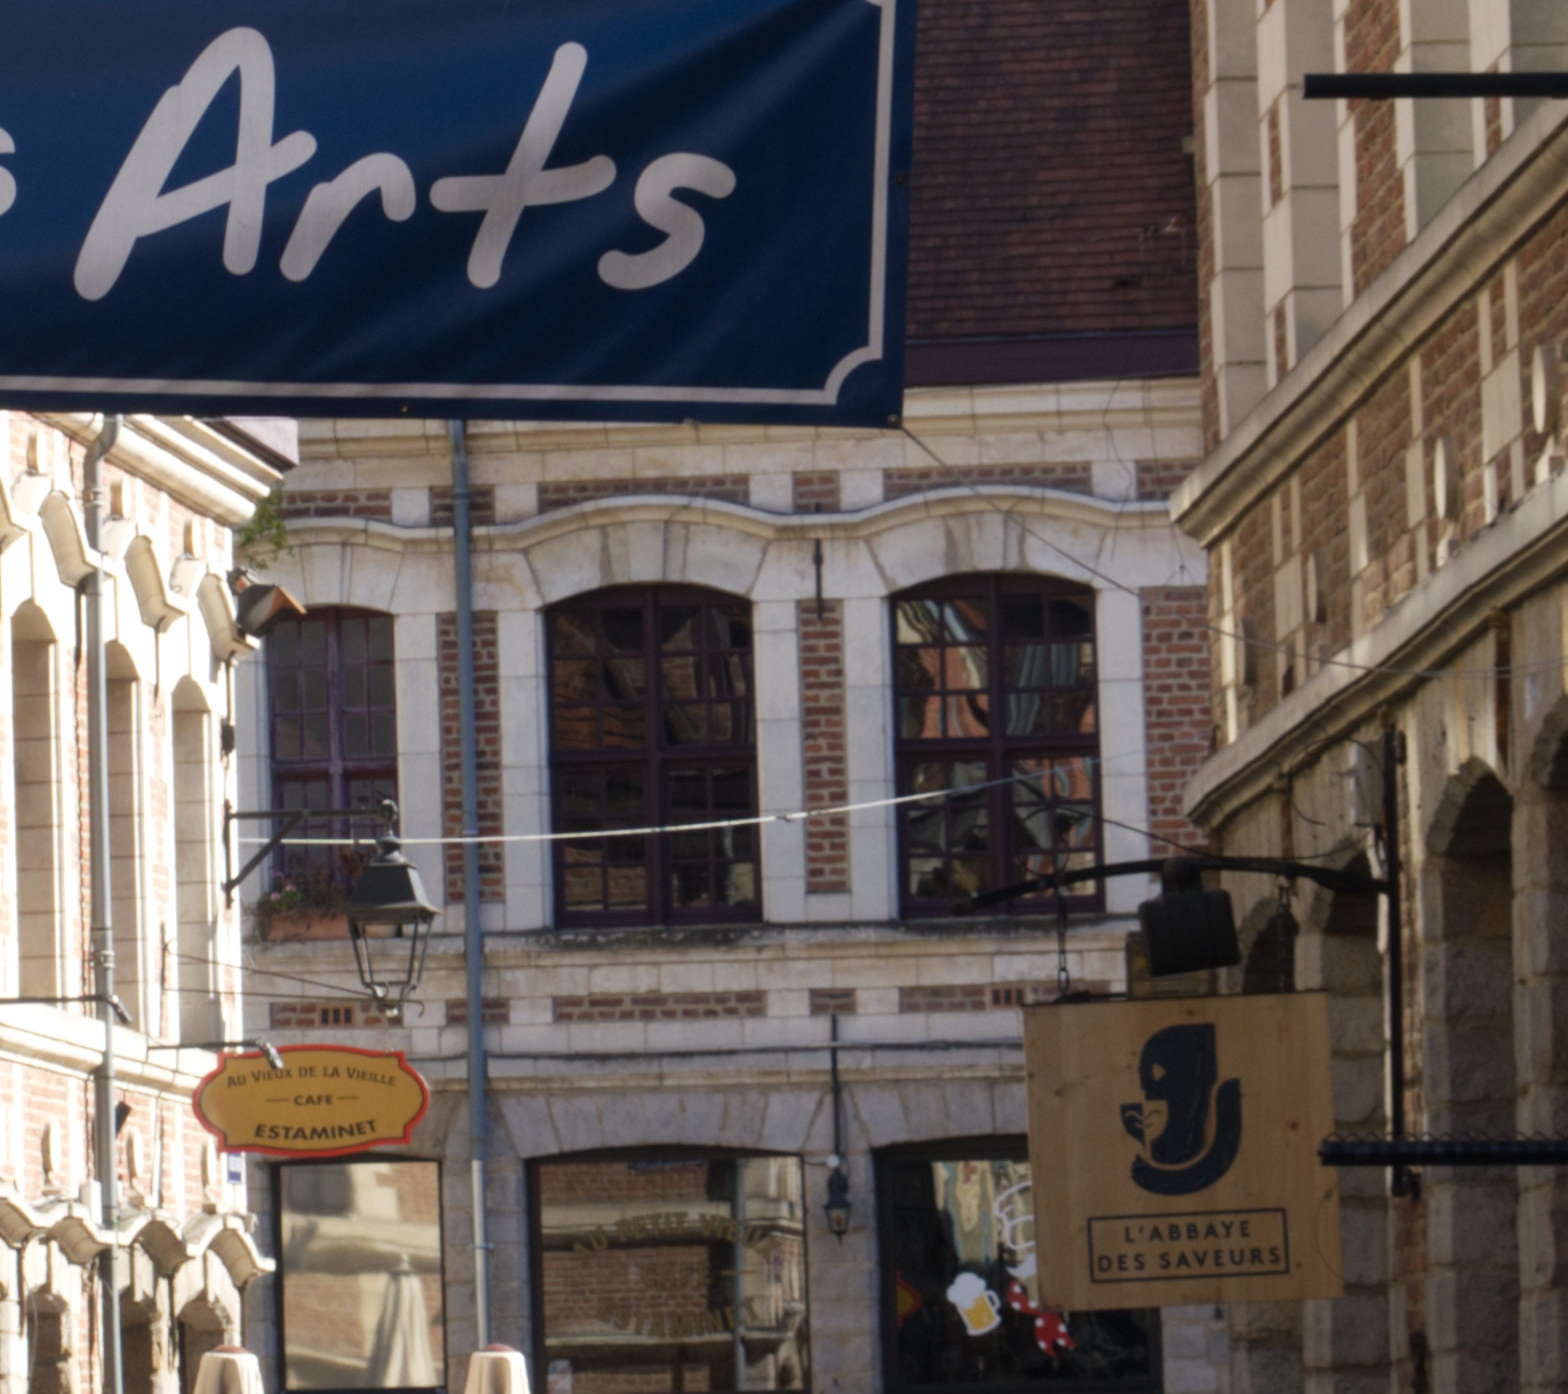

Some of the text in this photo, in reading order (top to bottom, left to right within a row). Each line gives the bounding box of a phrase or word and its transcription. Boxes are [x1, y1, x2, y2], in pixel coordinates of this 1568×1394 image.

[72, 25, 737, 302] Arts
[298, 1065, 316, 1078] DE
[322, 1065, 341, 1079] LA
[293, 1094, 334, 1107] CAFE
[253, 1119, 378, 1142] ESTAMINET
[614, 1211, 688, 1243] PETIT
[1124, 1220, 1252, 1245] L'ABBAYE
[1097, 1245, 1281, 1273] DES SAVEURS
[596, 1296, 760, 1338] ESTAMINET
